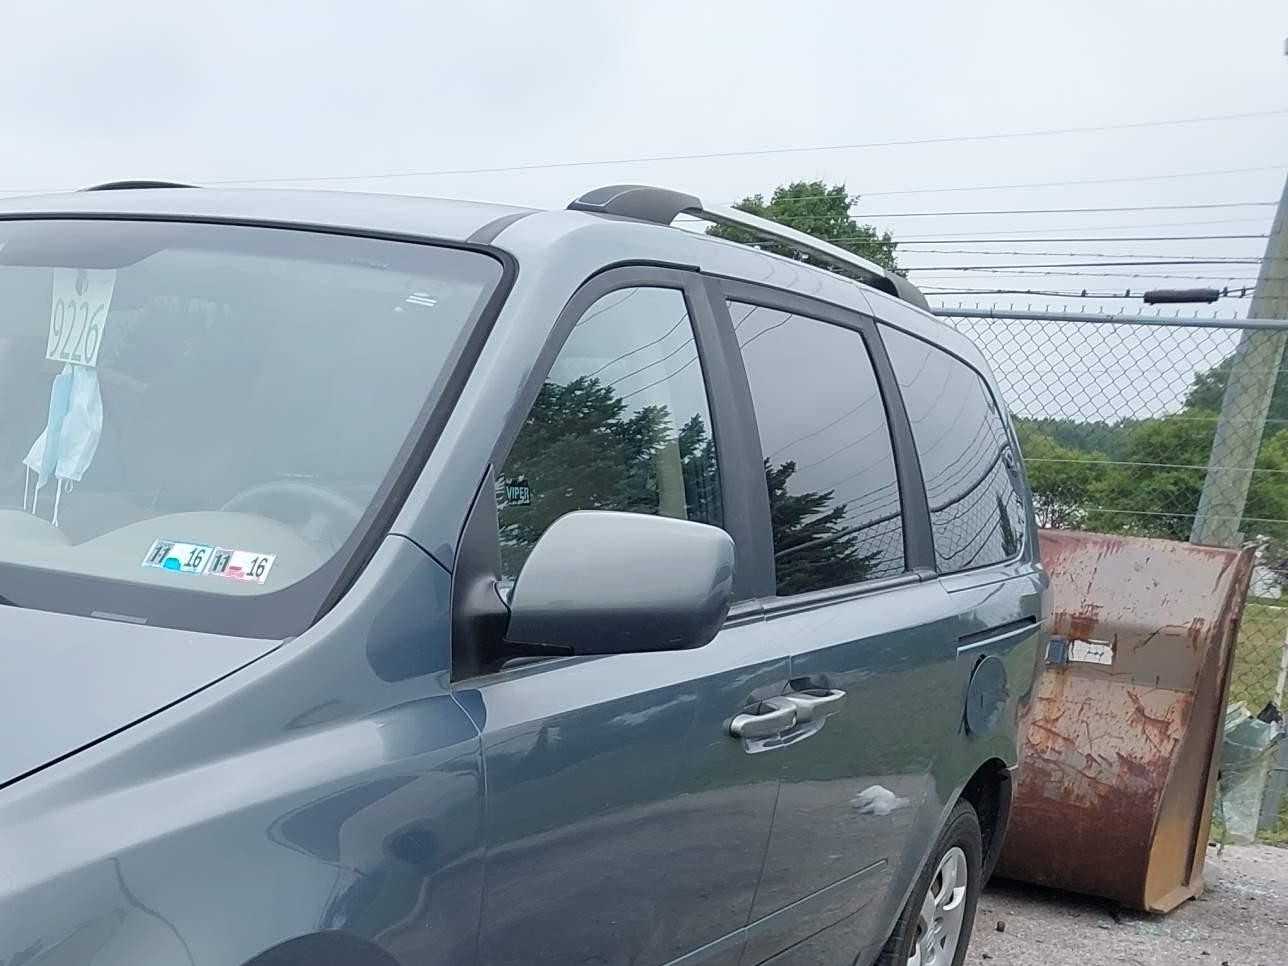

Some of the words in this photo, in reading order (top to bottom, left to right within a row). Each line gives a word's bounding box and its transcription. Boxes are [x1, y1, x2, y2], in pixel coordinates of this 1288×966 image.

[50, 297, 105, 364] 9226
[506, 486, 530, 501] VIPER
[184, 547, 206, 568] 16
[246, 556, 268, 578] 16
